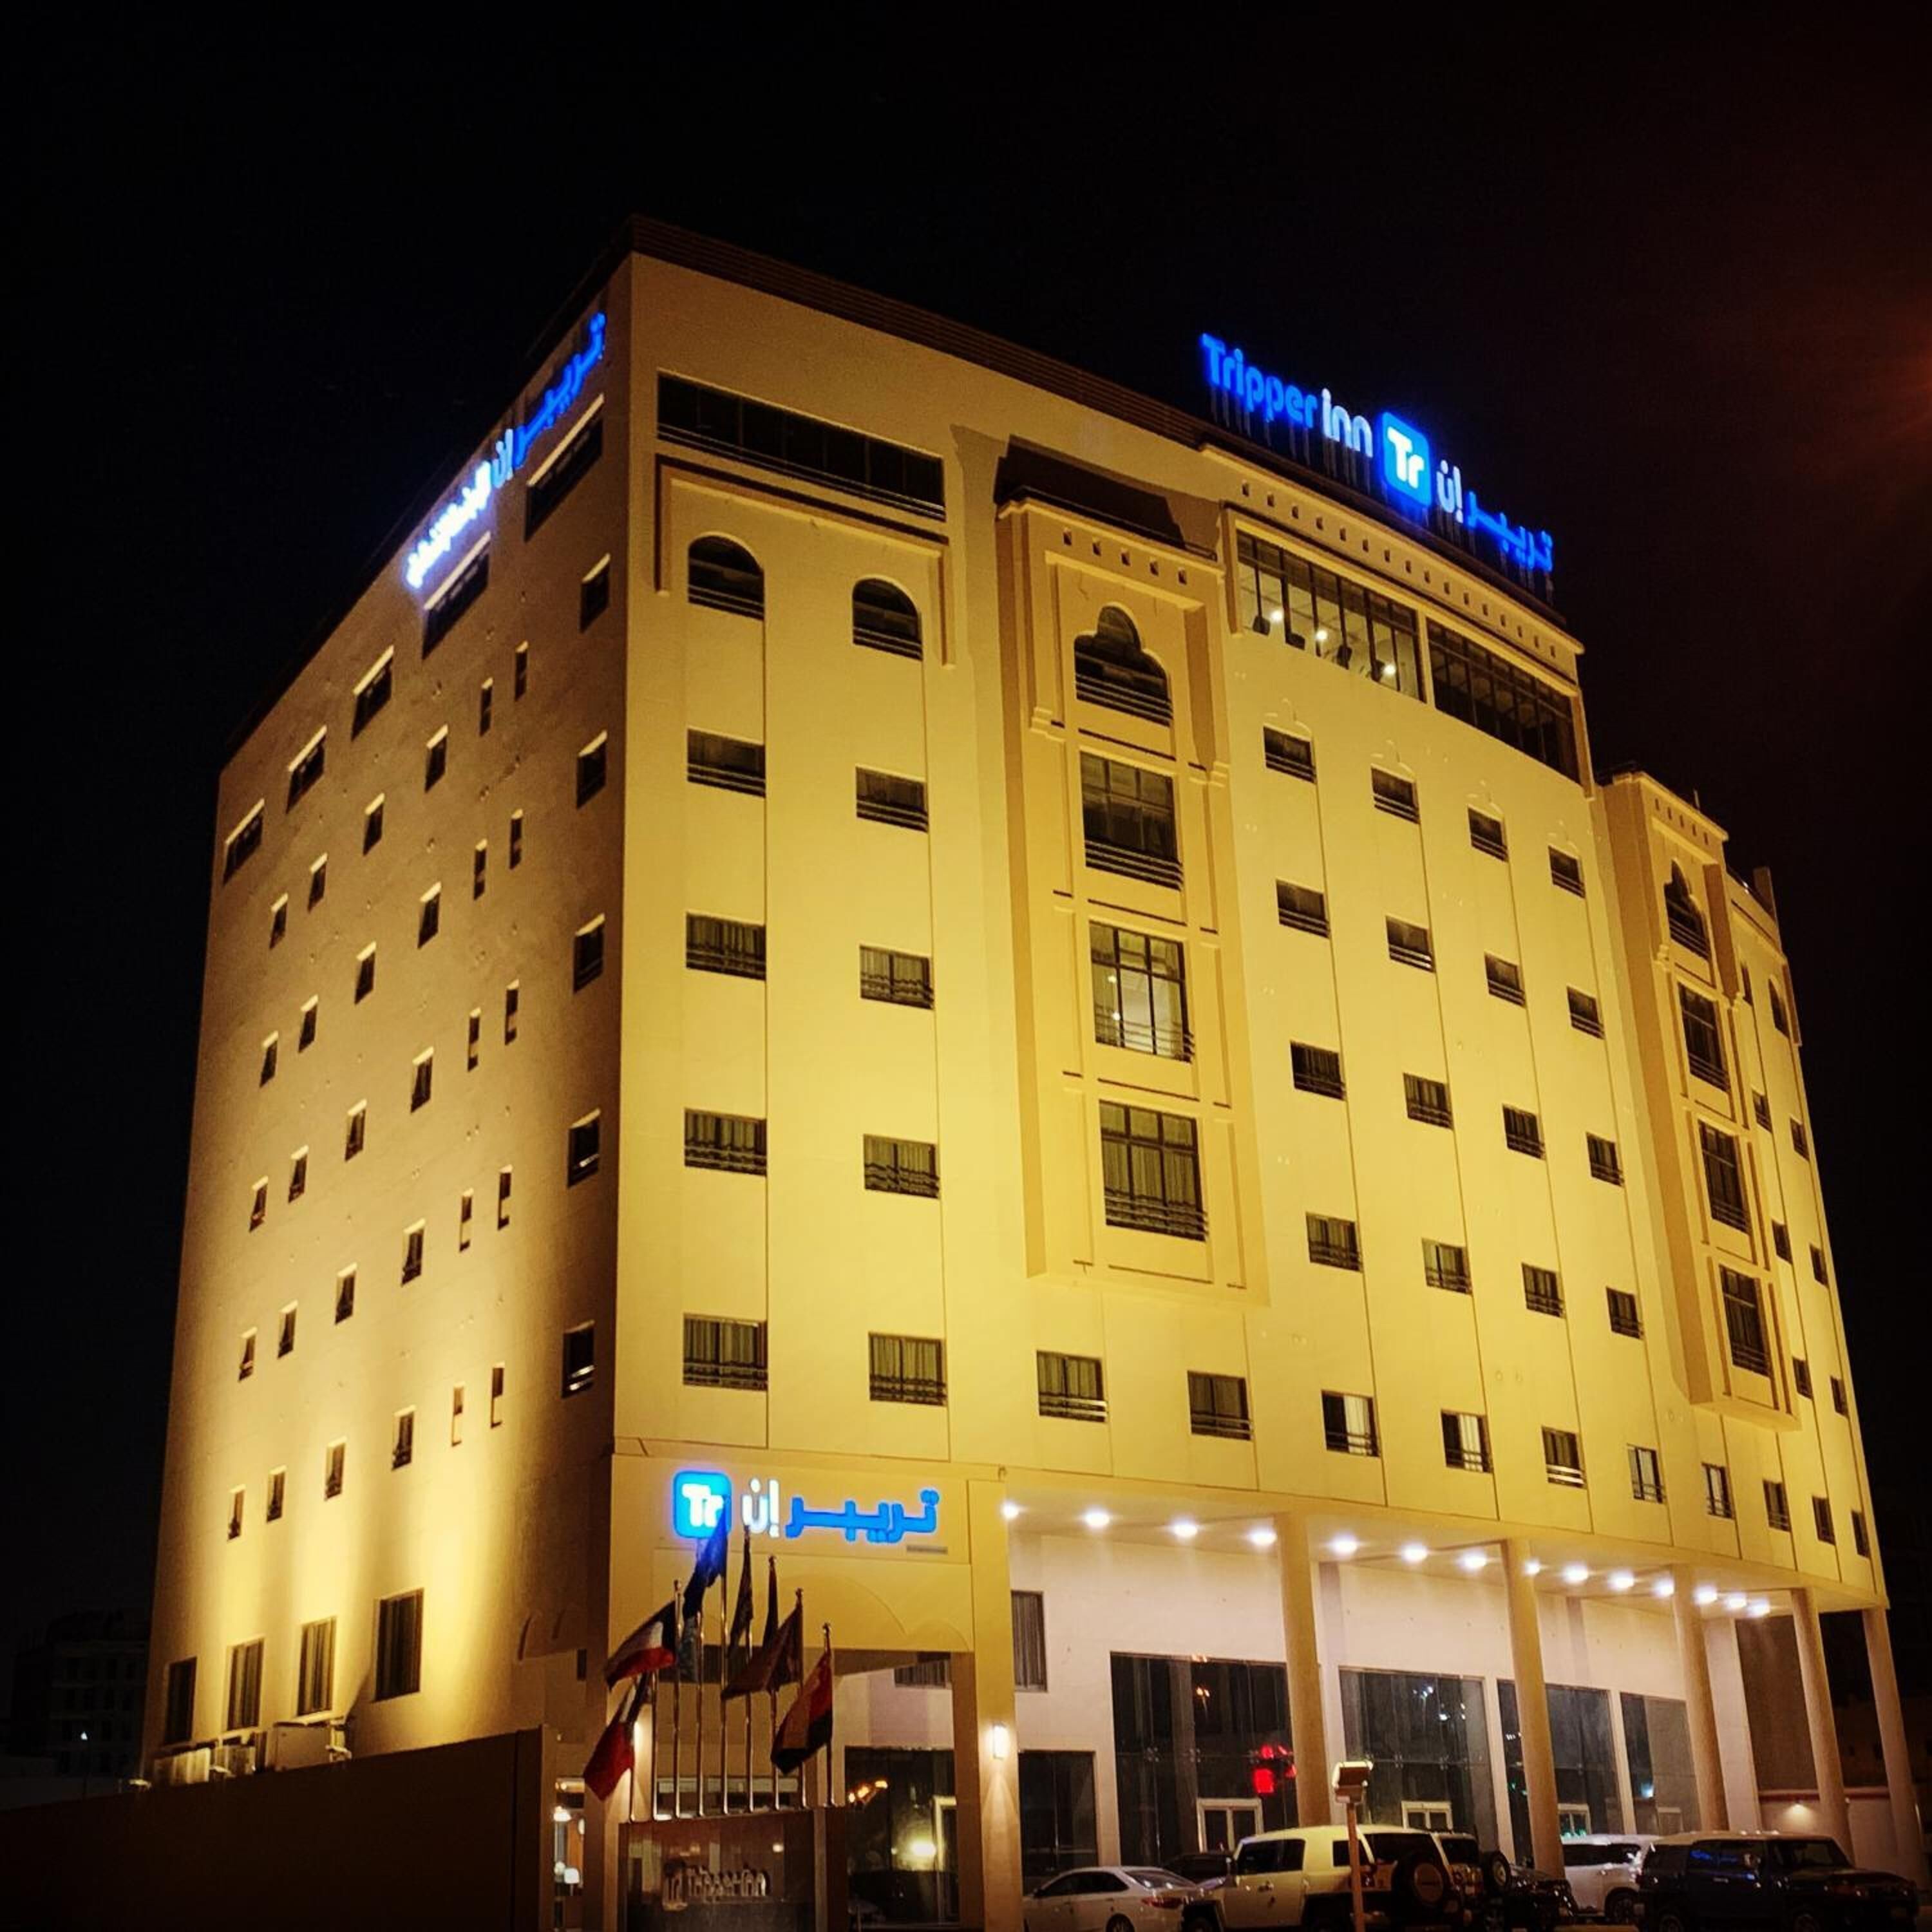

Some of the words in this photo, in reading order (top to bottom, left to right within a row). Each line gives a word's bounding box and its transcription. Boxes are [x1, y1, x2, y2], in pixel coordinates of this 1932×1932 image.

[1201, 332, 1318, 429] Tripper
[1321, 388, 1374, 458] inn
[681, 1482, 724, 1528] Tr
[784, 1489, 940, 1544] تريبر
